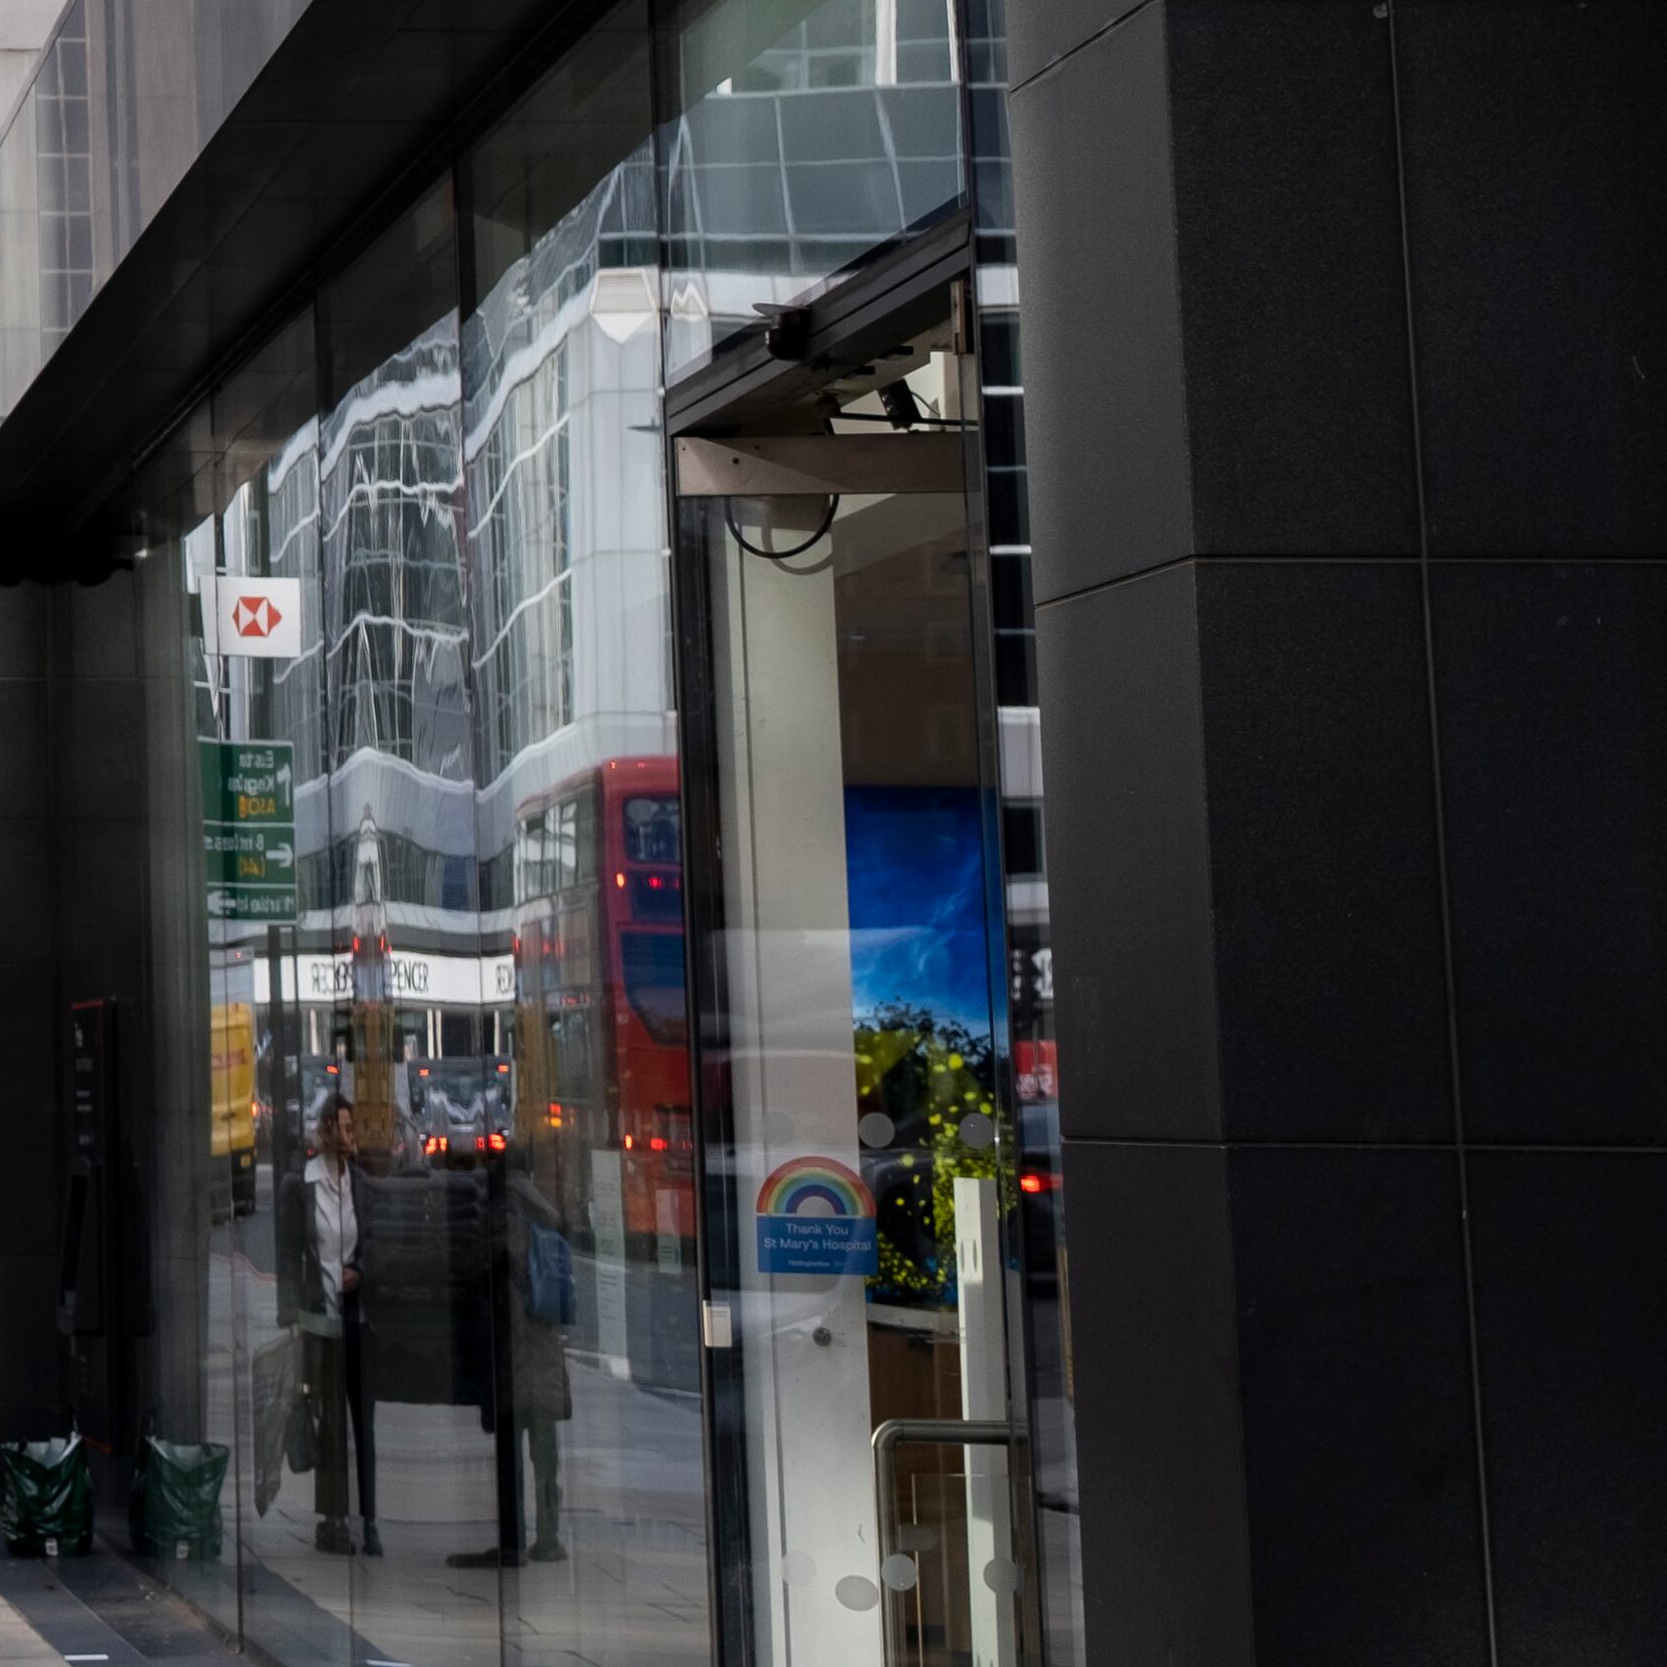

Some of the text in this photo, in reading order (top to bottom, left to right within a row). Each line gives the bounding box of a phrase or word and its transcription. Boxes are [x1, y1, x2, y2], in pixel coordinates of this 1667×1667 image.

[785, 1222, 849, 1236] Thank You
[763, 1237, 872, 1253] St Mary's Hospital
